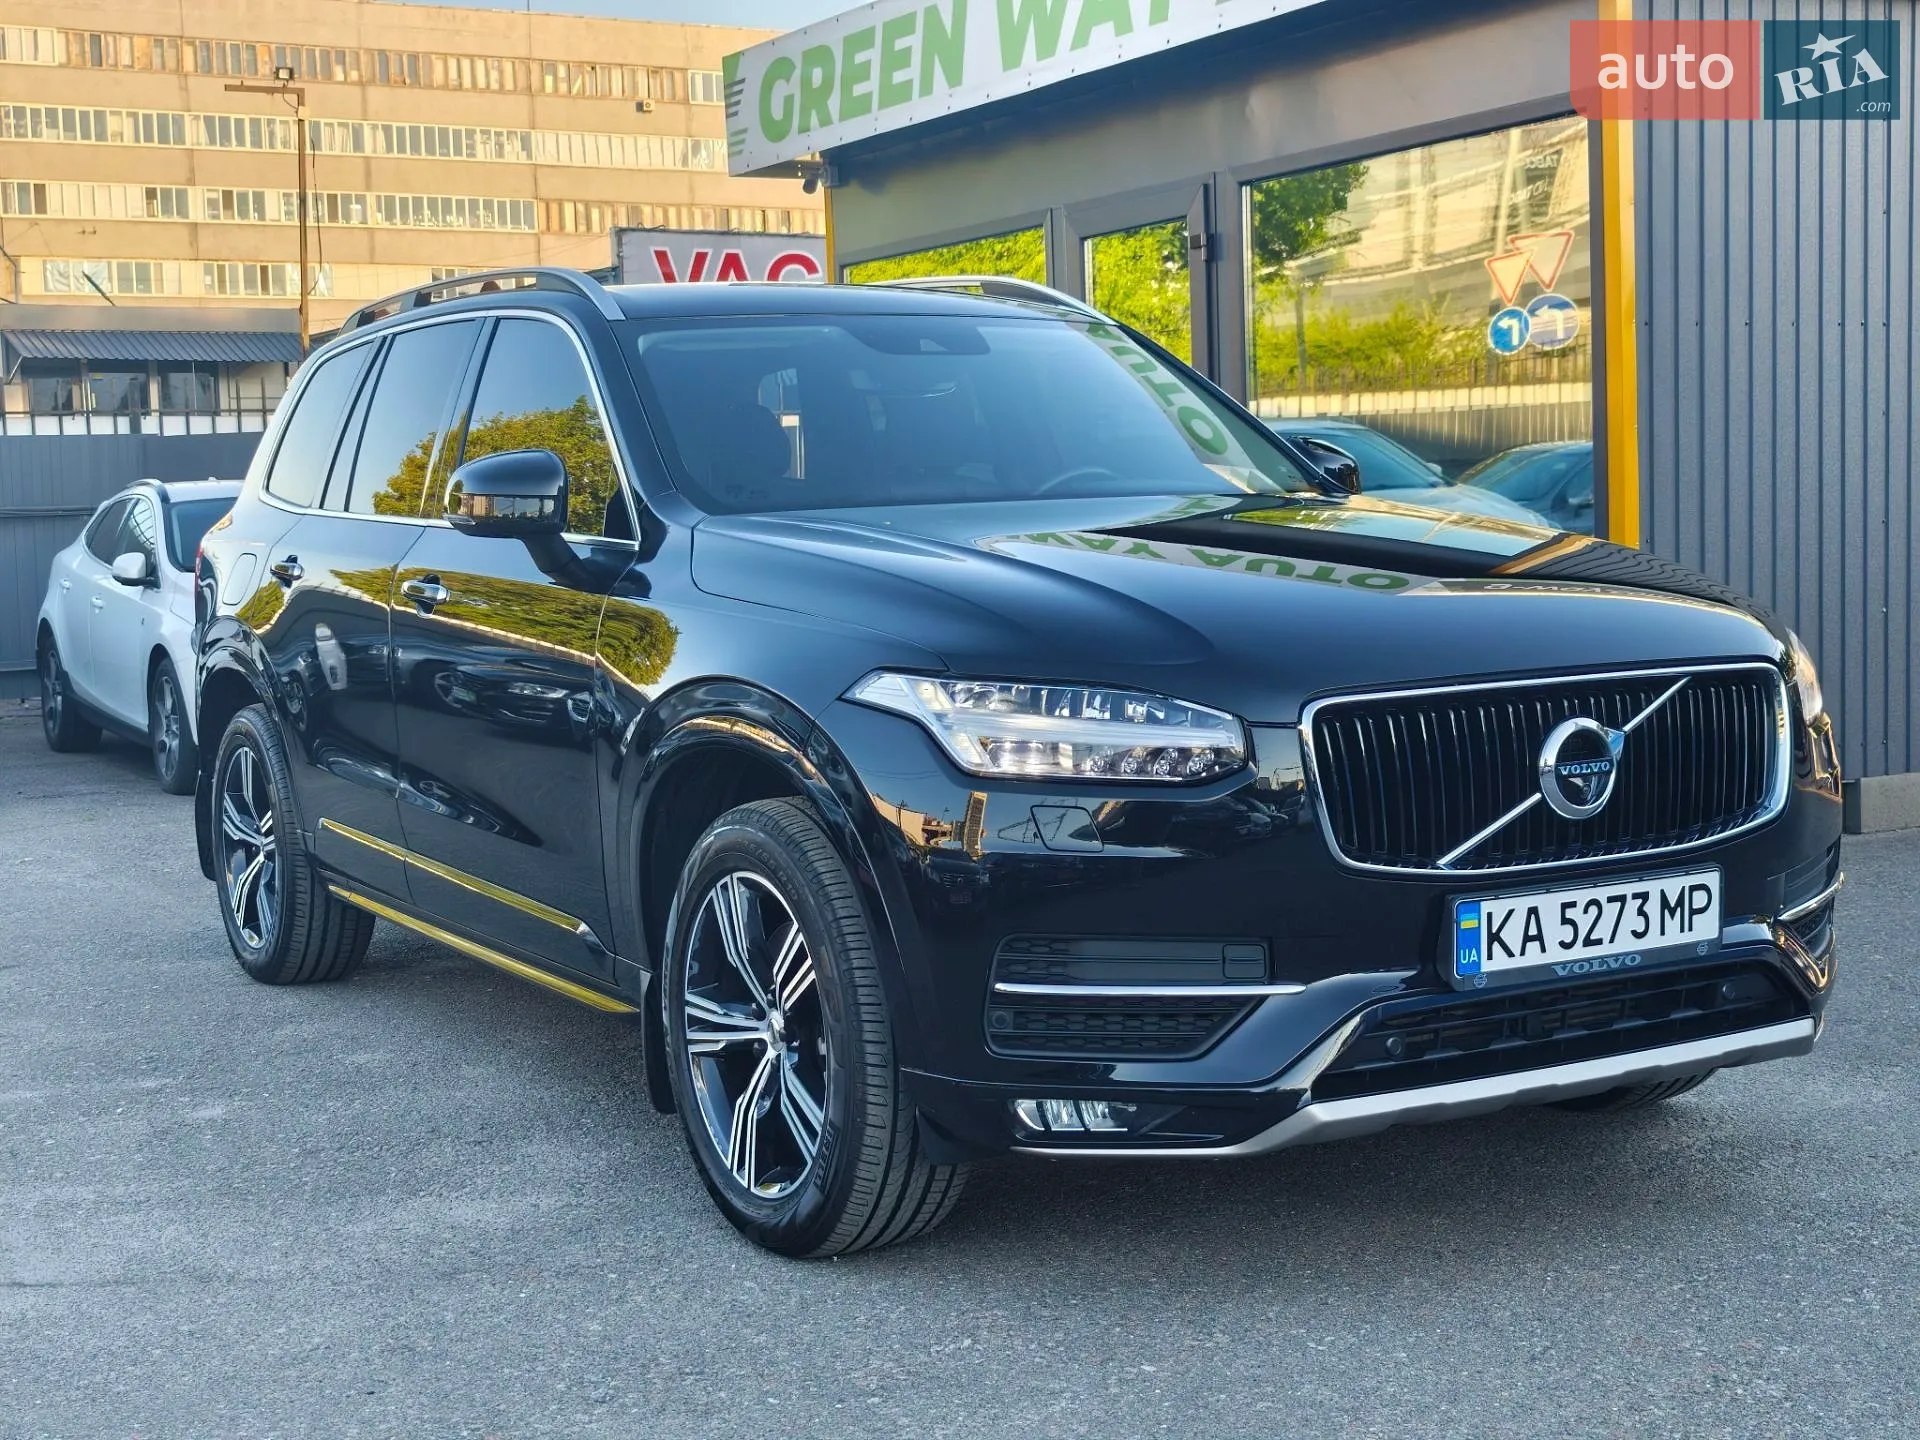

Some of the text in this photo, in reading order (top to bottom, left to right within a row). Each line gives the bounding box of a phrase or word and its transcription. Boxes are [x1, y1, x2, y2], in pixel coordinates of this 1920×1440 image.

[758, 0, 968, 144] GREEN
[1557, 760, 1611, 776] VOLVO
[1485, 882, 1713, 961] KA 5273 MP
[1459, 947, 1479, 965] UA
[1551, 953, 1642, 977] VOLVO
